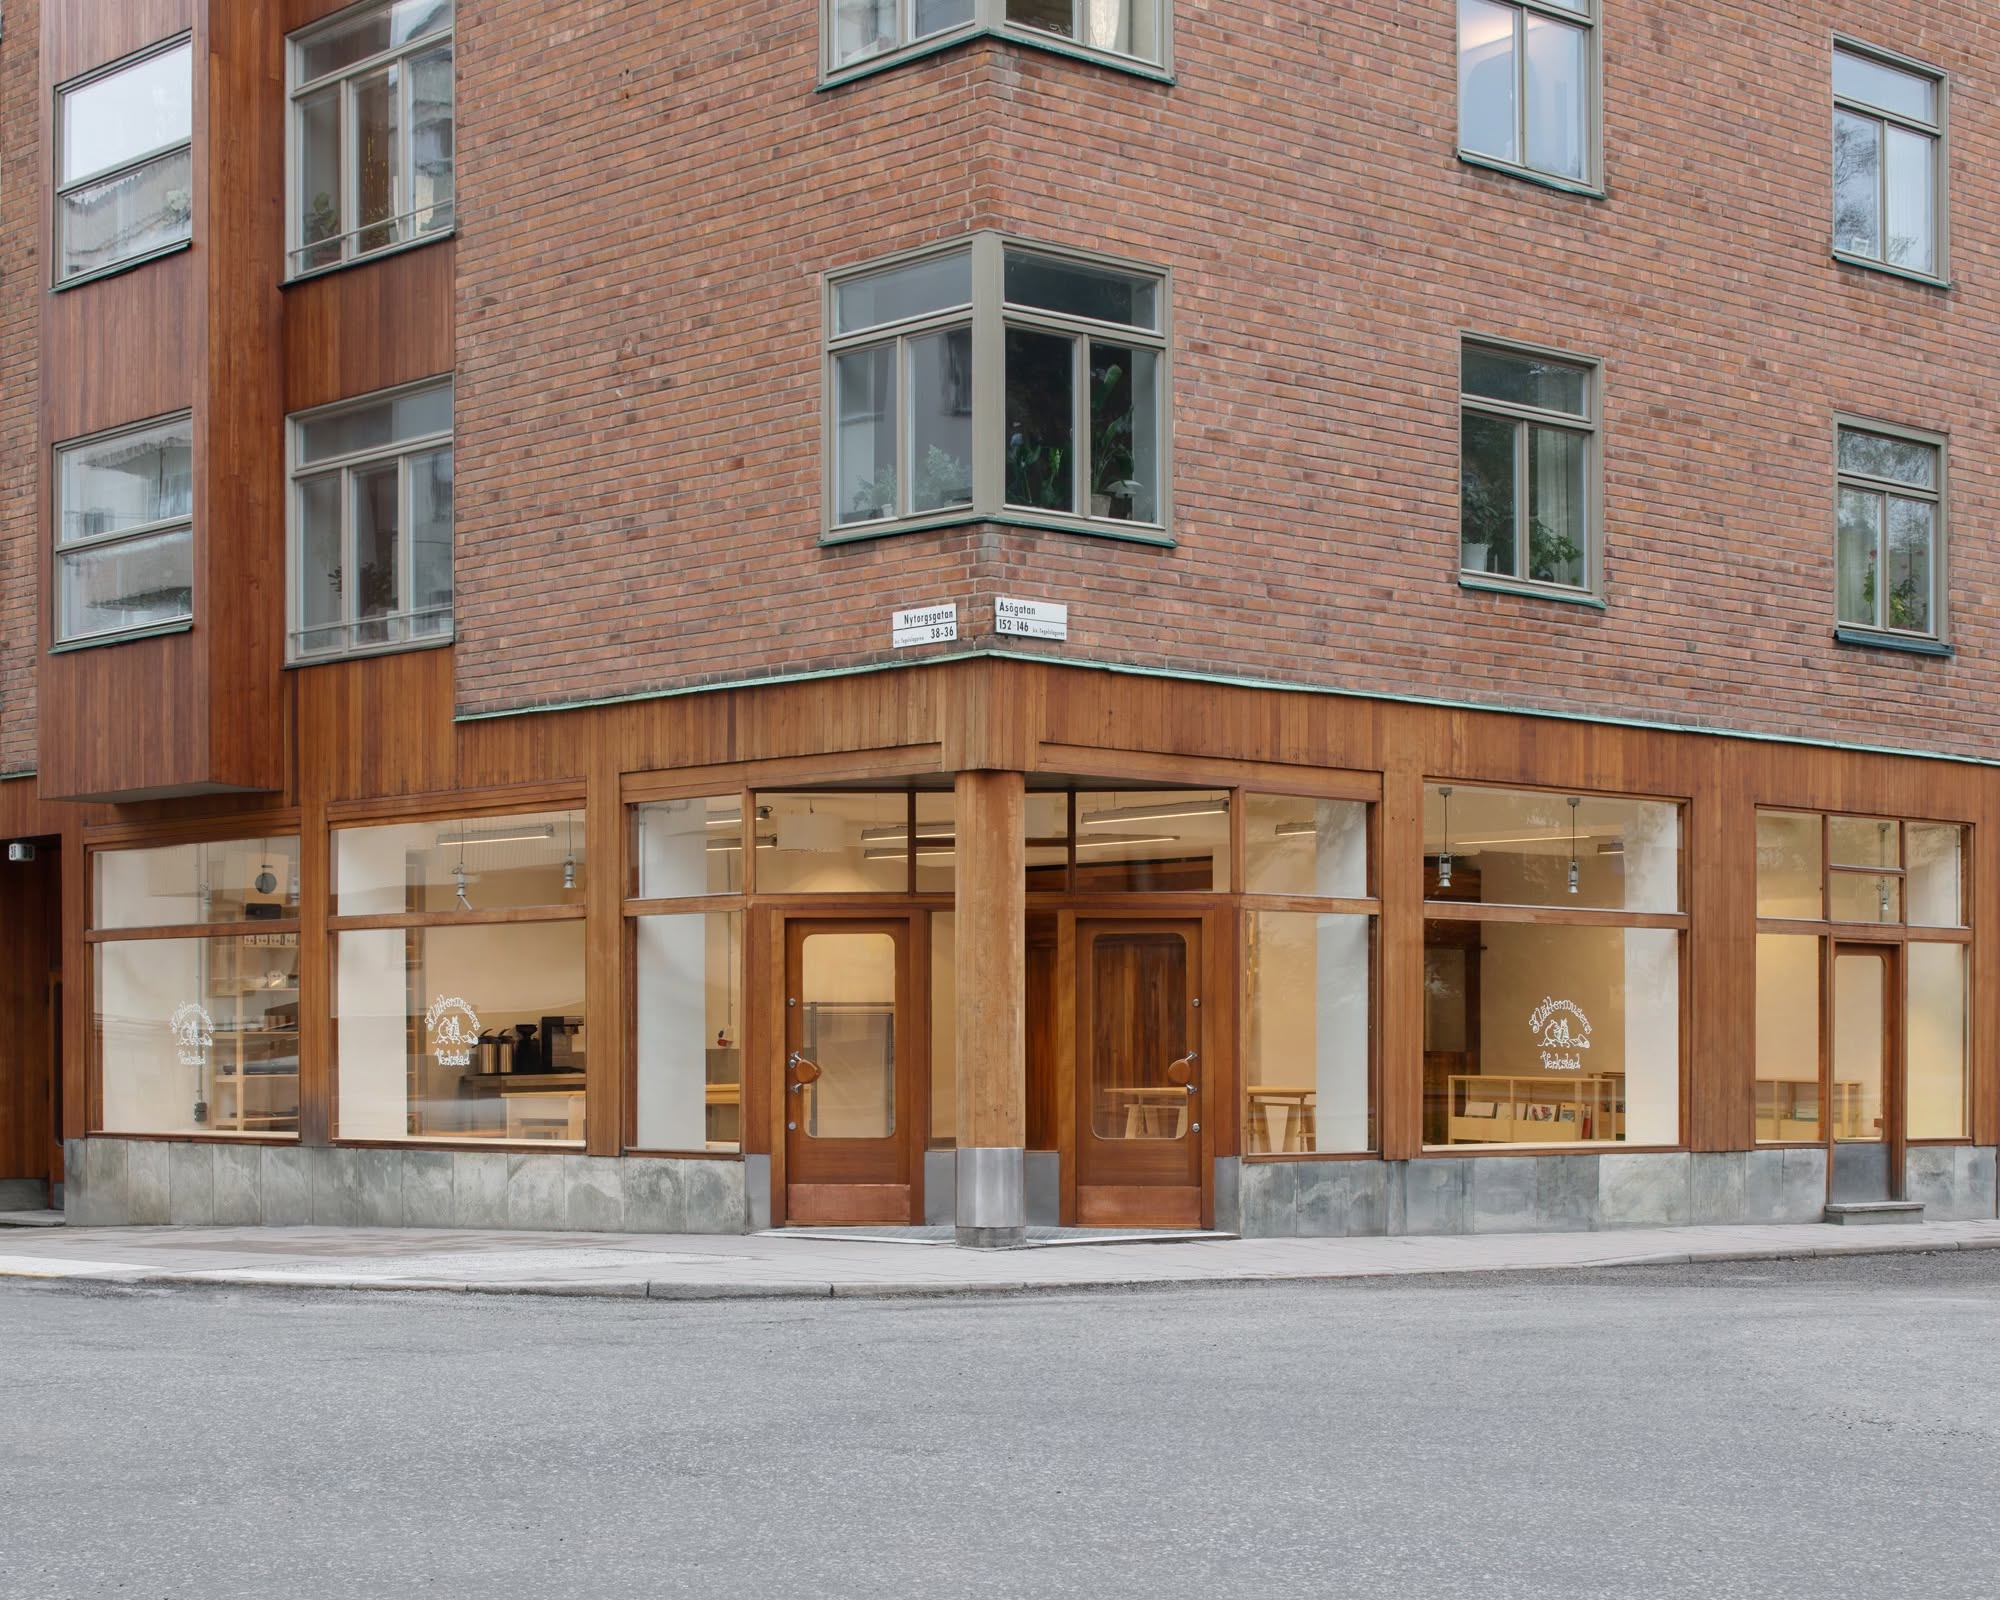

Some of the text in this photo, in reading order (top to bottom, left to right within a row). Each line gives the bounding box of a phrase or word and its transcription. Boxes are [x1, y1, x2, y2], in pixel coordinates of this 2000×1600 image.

[904, 610, 953, 626] Nytorgsgatan
[999, 619, 1012, 630] 152
[930, 626, 954, 639] 38-36
[1540, 1050, 1581, 1070] Verkstad
